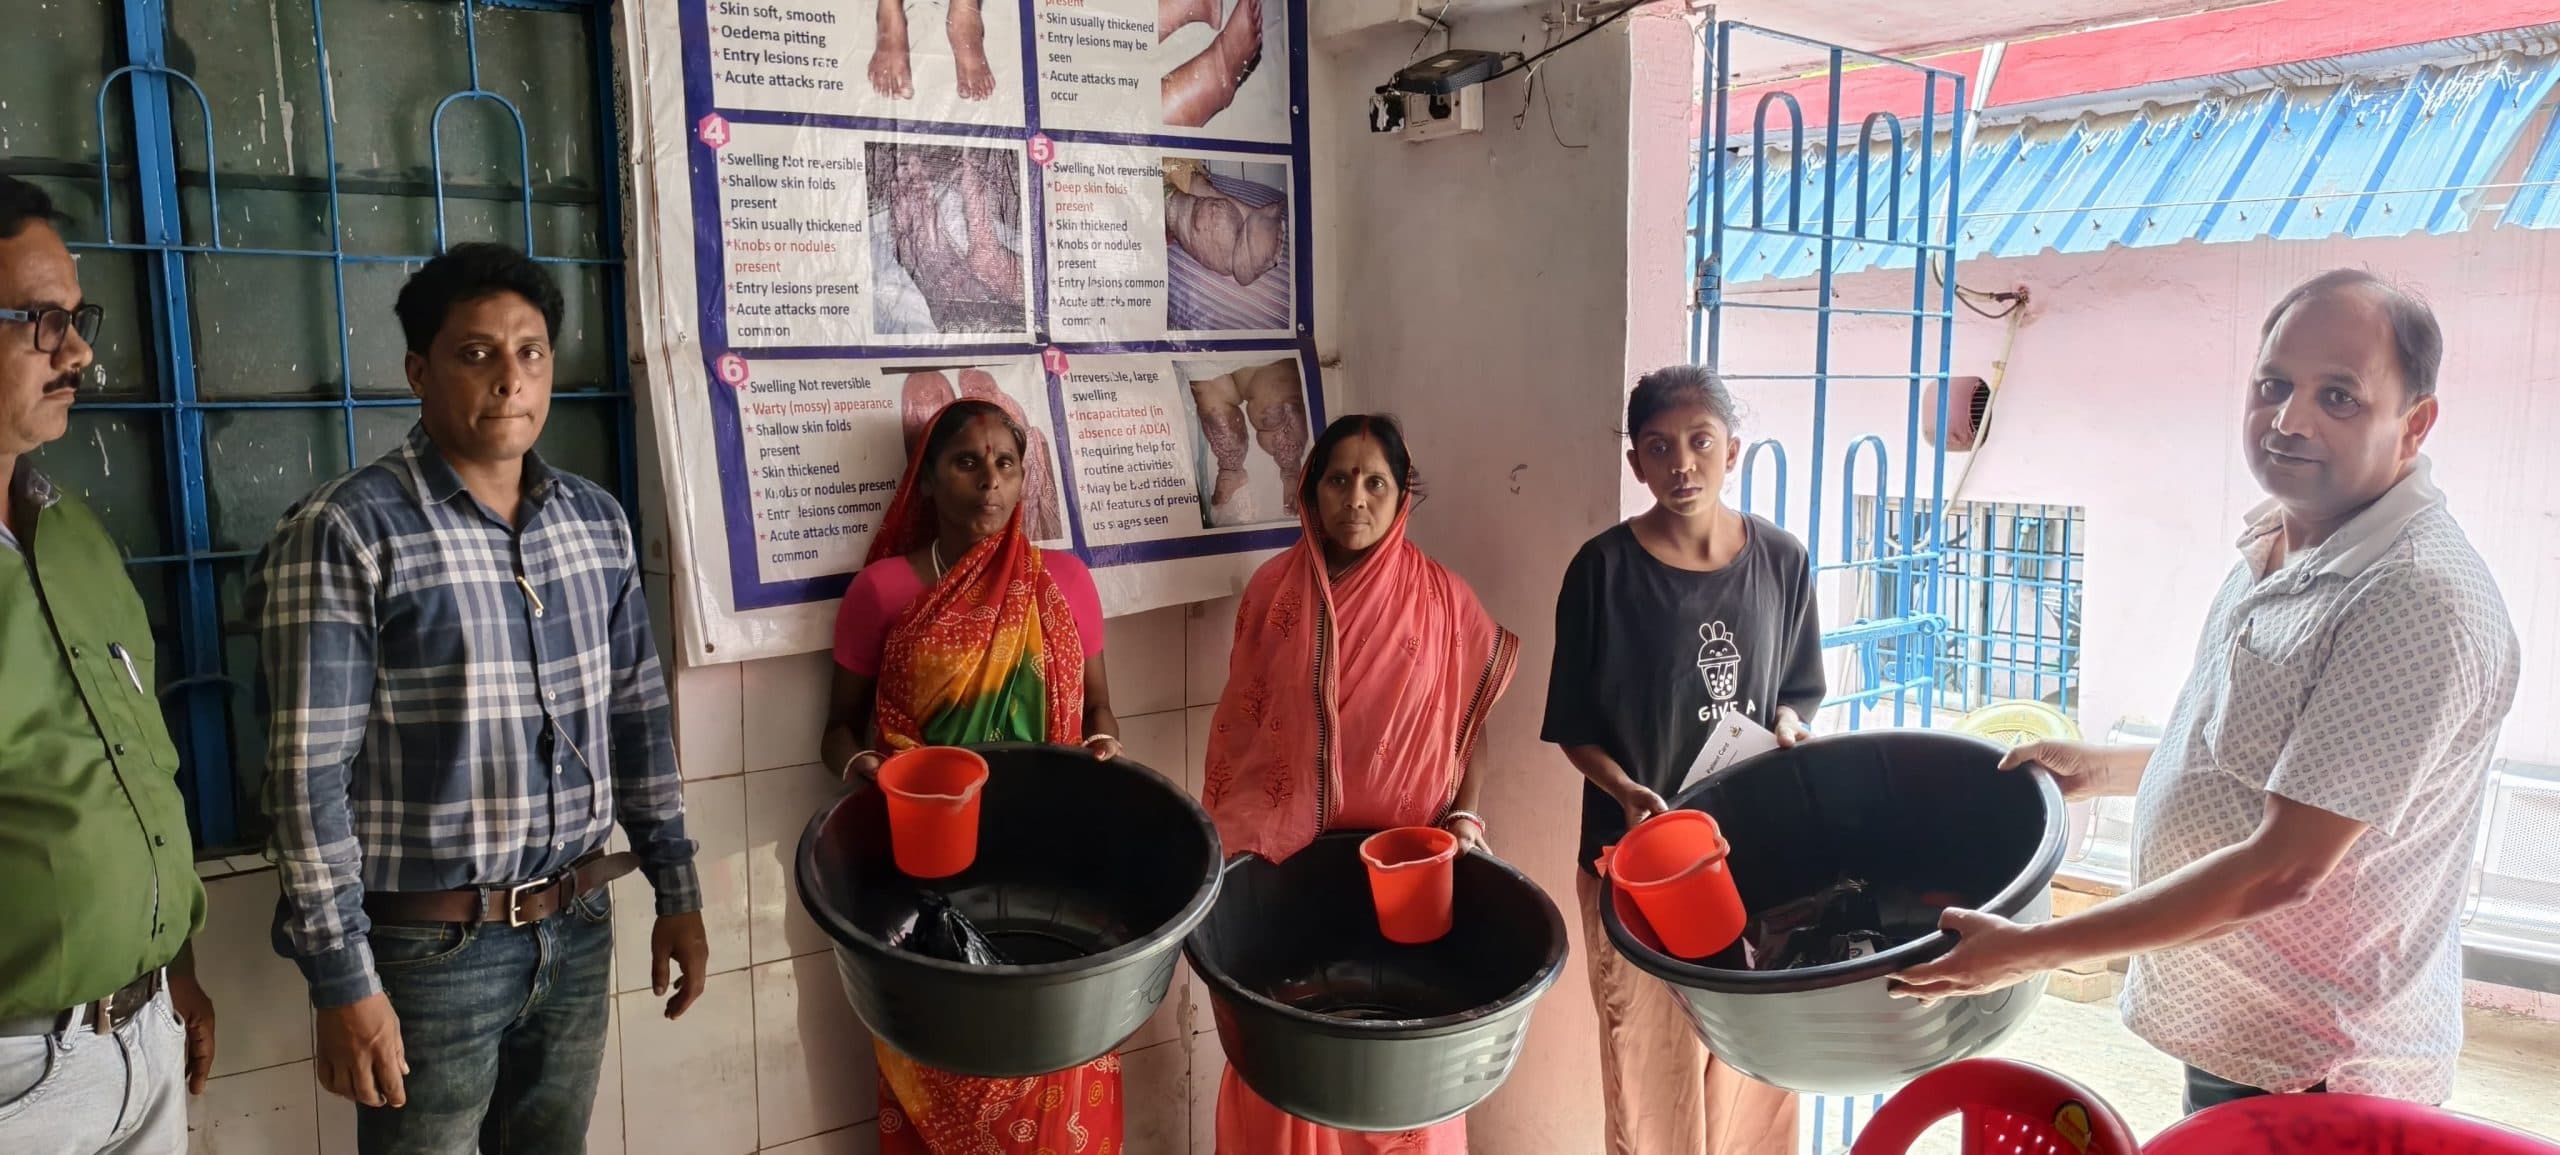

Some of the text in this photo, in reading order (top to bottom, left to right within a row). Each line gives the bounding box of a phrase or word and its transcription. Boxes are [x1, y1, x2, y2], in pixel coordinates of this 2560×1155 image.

[719, 2, 836, 25] Skin soft, smooth
[1047, 12, 1154, 32] Skin usually thickened
[721, 25, 826, 48] Oedema pitting
[1047, 32, 1148, 52] Entry lesions may be
[723, 48, 760, 65] Entry
[764, 50, 809, 66] lesions
[1049, 53, 1072, 63] seen
[725, 70, 843, 91] Acute attacks rare
[1050, 70, 1139, 88] Acute attacks may
[1051, 90, 1078, 101] occur
[704, 118, 725, 144] 4
[1033, 139, 1049, 160] 5
[728, 154, 779, 170] Swelling
[1053, 162, 1164, 178] Swelling Not reversible
[729, 175, 836, 190] Shallow skin folds
[1054, 182, 1081, 194] Deep
[1083, 184, 1103, 194] skin
[731, 197, 777, 209] present
[1056, 202, 1094, 213] present
[732, 218, 862, 233] Skin usually thickened
[1056, 220, 1128, 232] Skin thickened
[734, 239, 836, 253] Knobs or nodules
[1057, 240, 1142, 251] Knobs or nodules
[735, 260, 781, 273] present
[1058, 259, 1096, 270] present
[736, 282, 859, 297] Entry lesions present
[1059, 278, 1085, 290] Entry
[1124, 279, 1165, 288] common
[736, 303, 850, 316] Acute attacks more
[1059, 297, 1088, 307] Acute
[1127, 297, 1152, 307] more
[738, 326, 791, 337] common
[722, 356, 743, 382] 6
[1048, 351, 1061, 375] 7
[1134, 370, 1159, 383] large
[750, 378, 871, 394] Swelling Not reversible
[1072, 389, 1117, 402] swelling
[753, 399, 893, 416] Warty (mossy) appearance
[1075, 404, 1163, 421] Incapacitated (in
[756, 420, 851, 436] Shallow skin folds
[1079, 423, 1171, 439] absence of ADLA)
[759, 445, 800, 460] present
[1081, 441, 1176, 458] Requiring help for
[762, 462, 840, 479] Skin thickened
[1084, 460, 1173, 476] routine activities
[800, 486, 810, 497] or
[815, 481, 856, 496] nodules
[859, 479, 896, 493] present
[1113, 481, 1127, 493] be
[1153, 476, 1185, 488] ridden
[838, 501, 881, 514] common
[1154, 495, 1165, 506] of
[1093, 520, 1105, 531] us
[1144, 515, 1168, 527] seen
[770, 522, 868, 542] Acute attacks more
[772, 548, 818, 563] common
[1746, 699, 1756, 715] A
